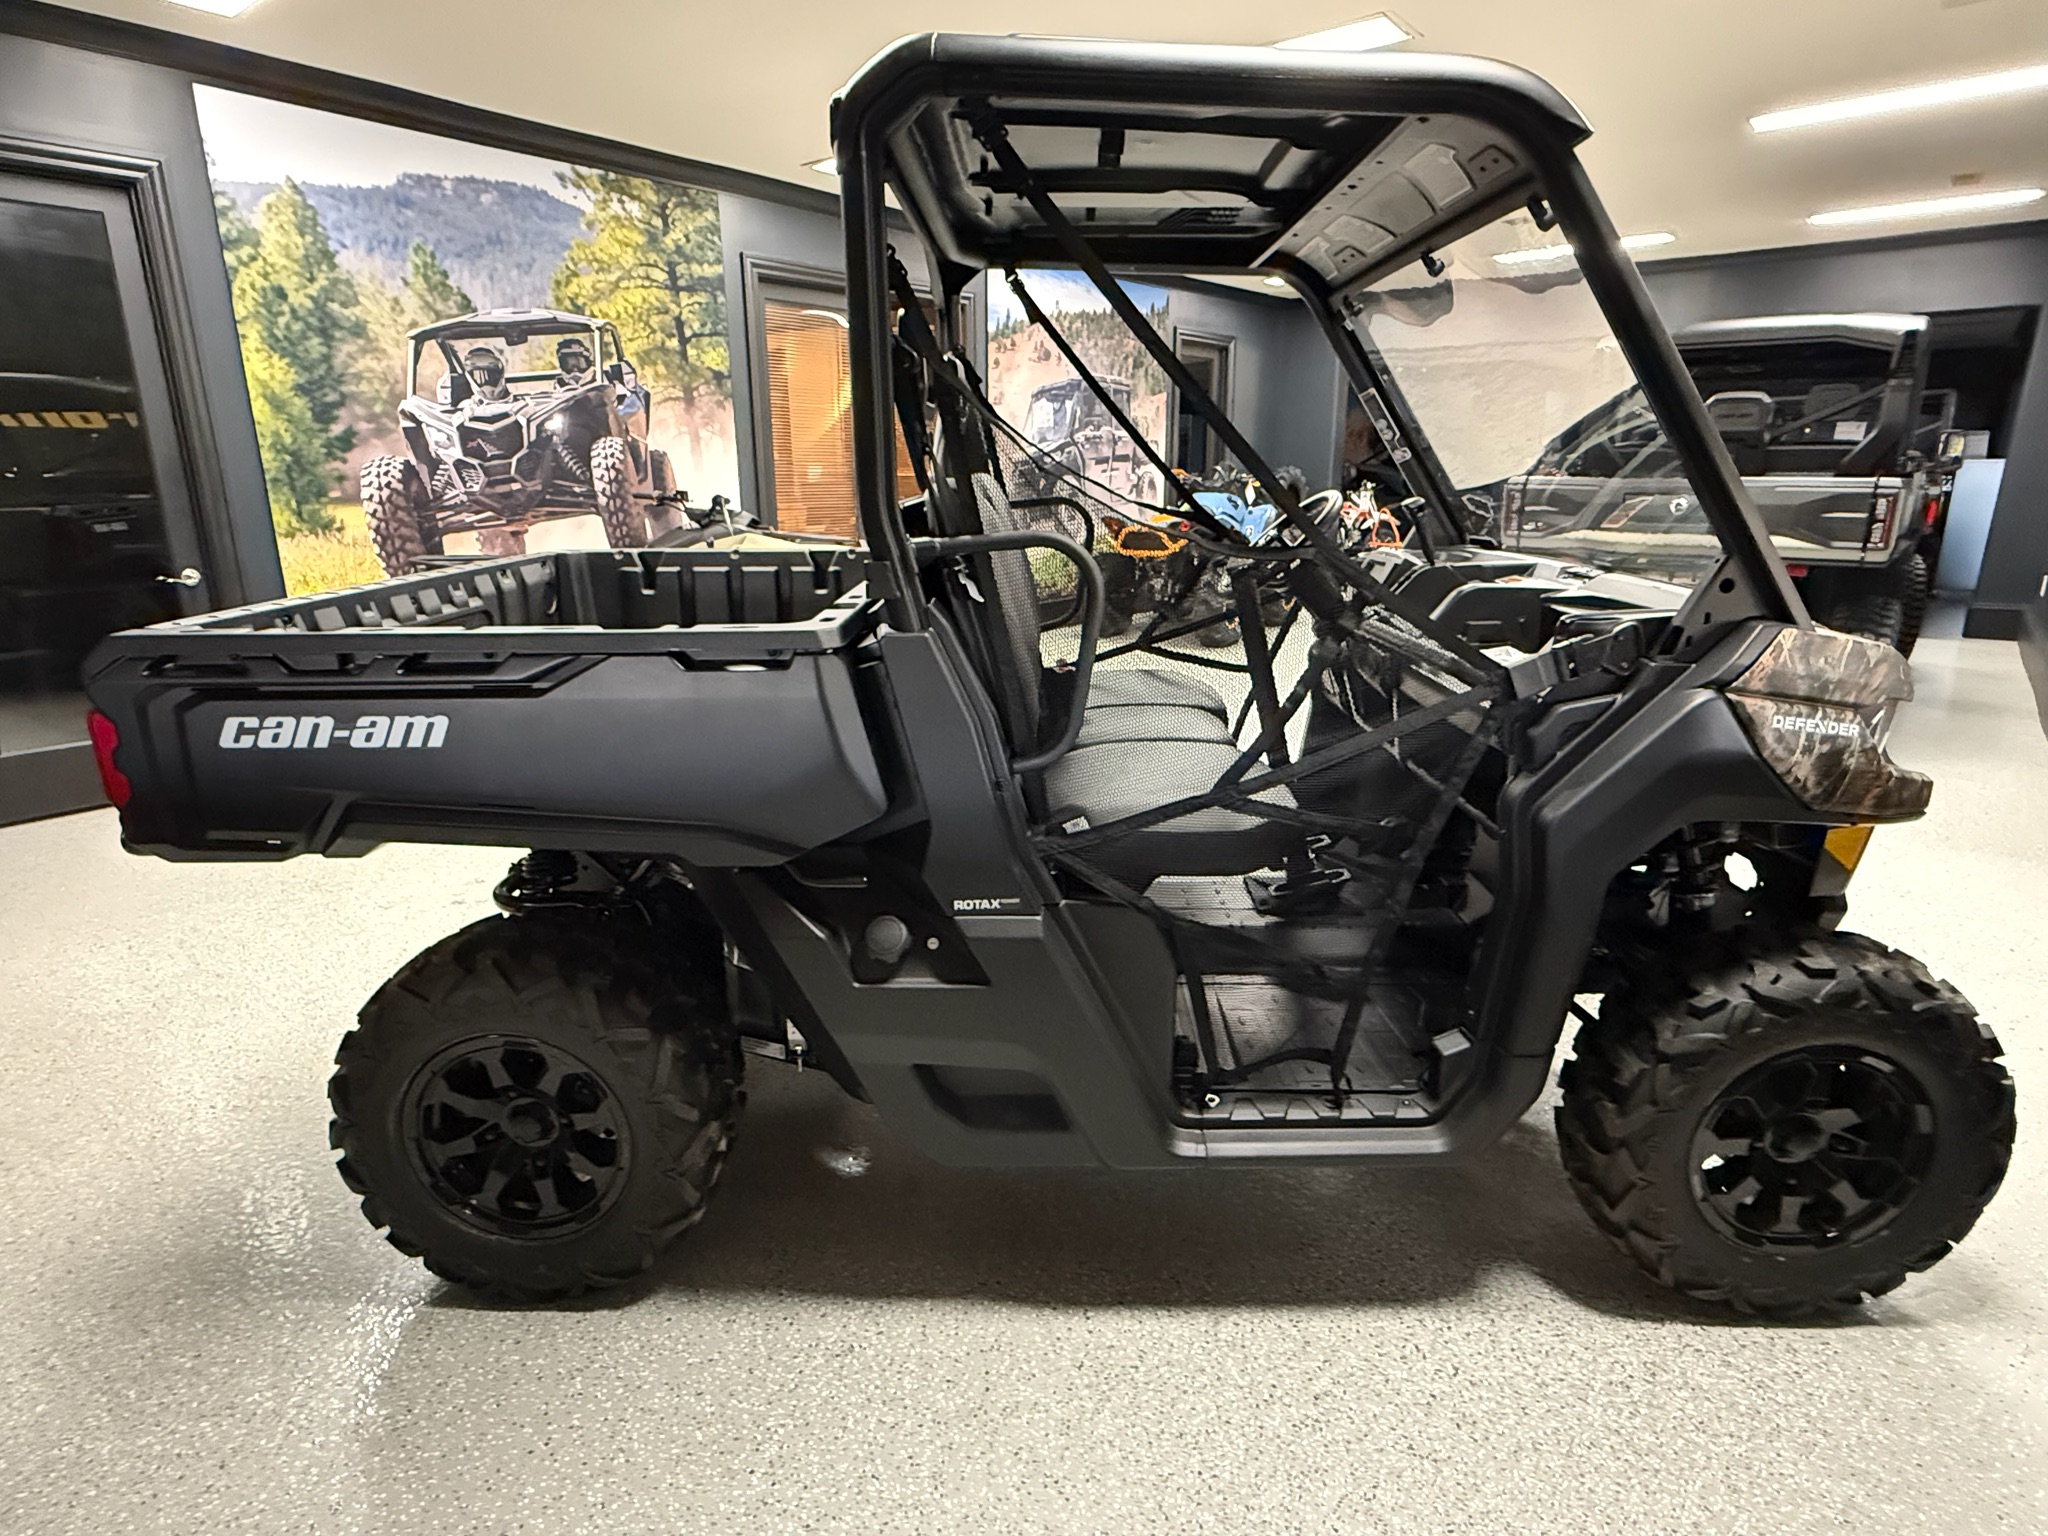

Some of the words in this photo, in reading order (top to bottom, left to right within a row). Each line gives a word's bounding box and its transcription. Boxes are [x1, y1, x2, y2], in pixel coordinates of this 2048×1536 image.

[218, 715, 450, 749] can-am
[1772, 715, 1860, 736] DEFENDER
[953, 898, 1001, 911] ROTAX
